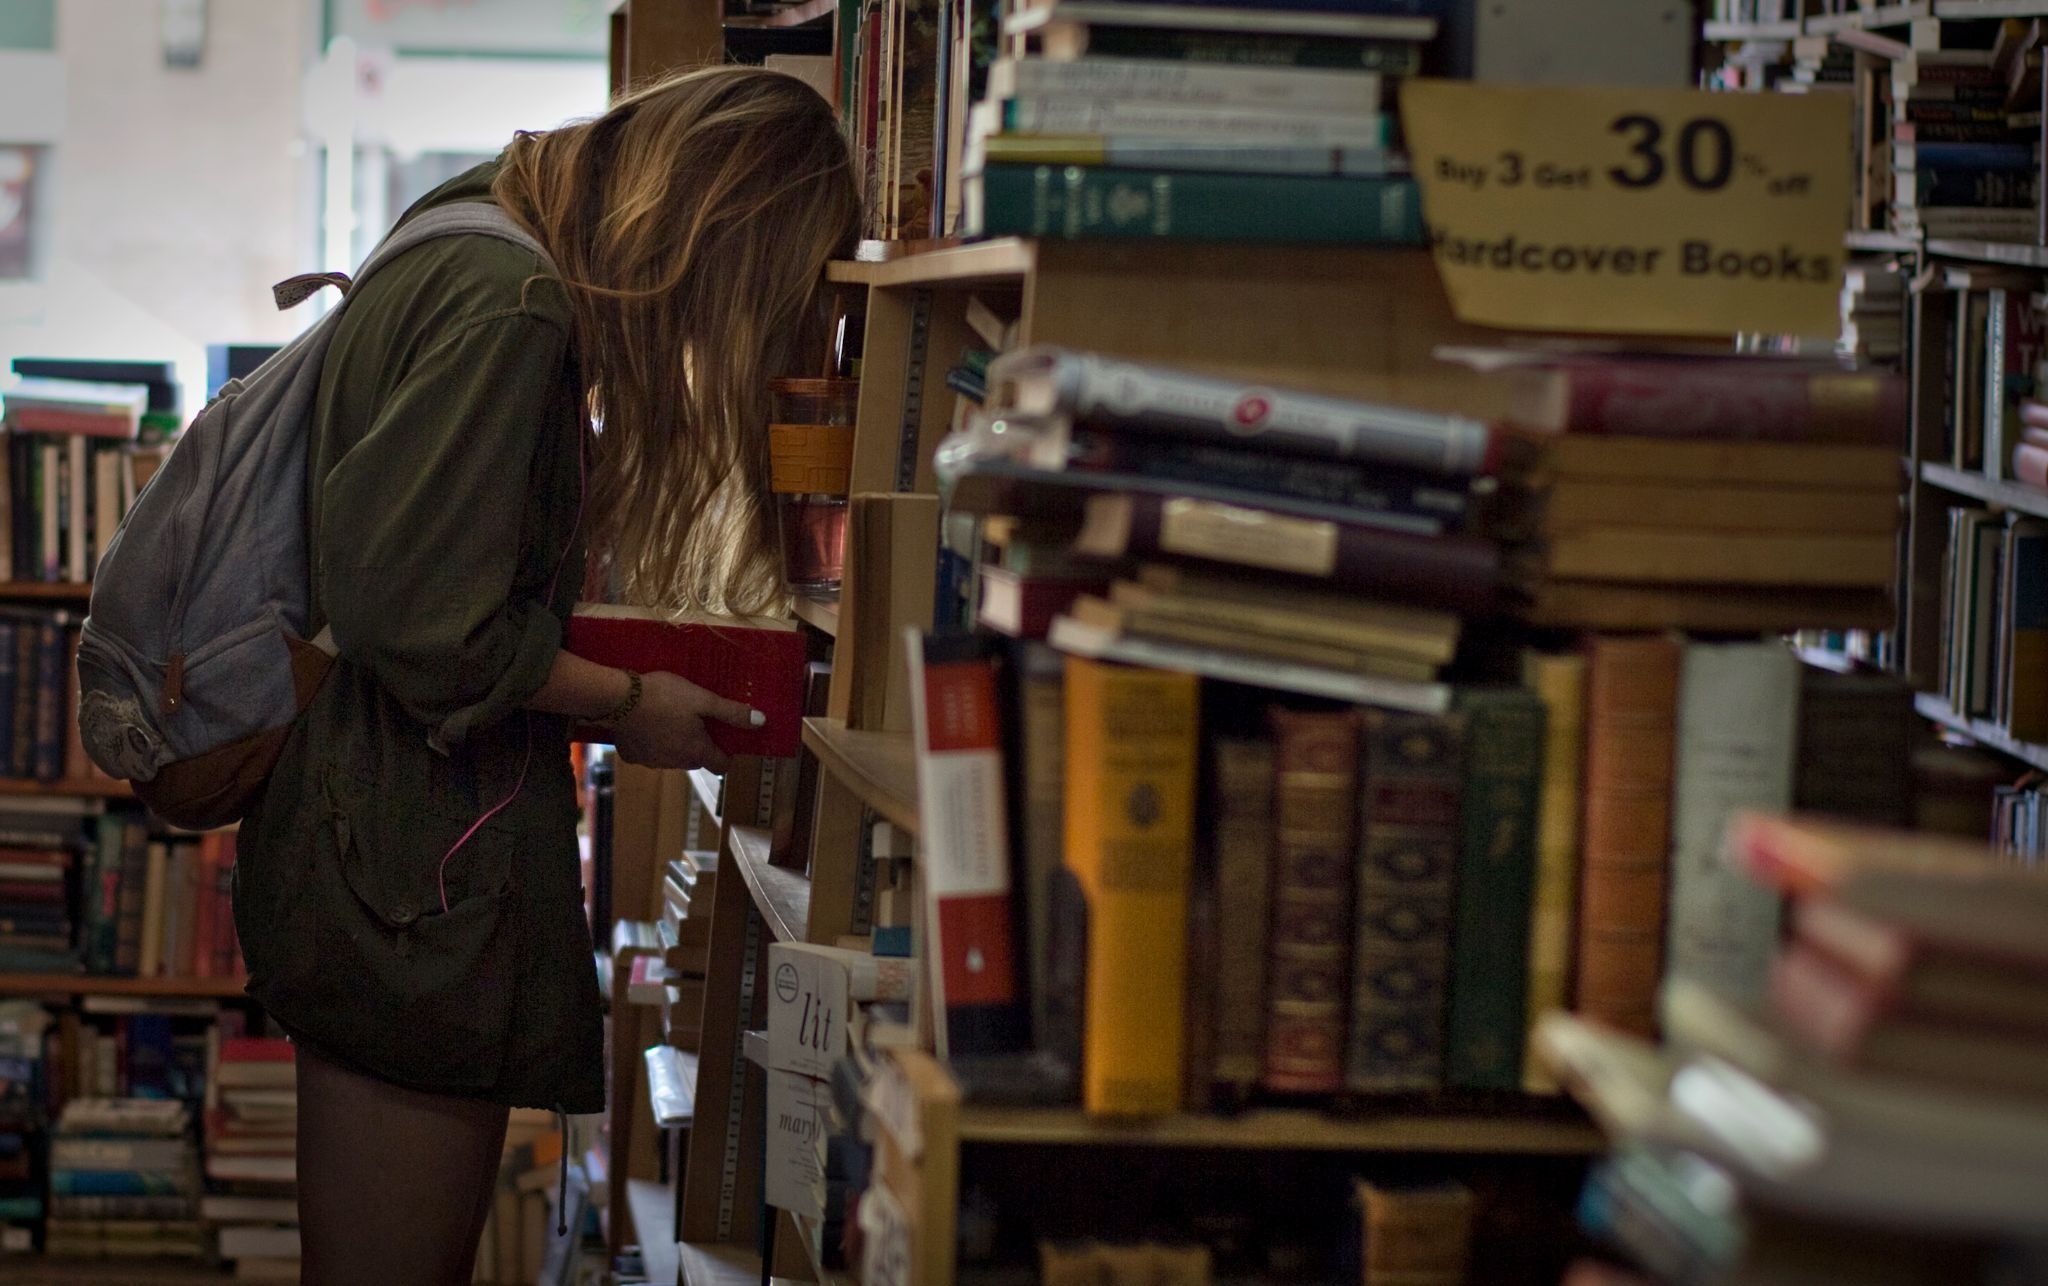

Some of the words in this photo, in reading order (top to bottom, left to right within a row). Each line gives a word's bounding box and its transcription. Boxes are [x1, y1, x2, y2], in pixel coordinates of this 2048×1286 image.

[1434, 157, 1488, 191] Buy
[1498, 152, 1526, 187] 3
[1534, 163, 1591, 190] Get
[1766, 173, 1812, 195] off
[1681, 237, 1835, 284] Books
[799, 992, 832, 1052] lit
